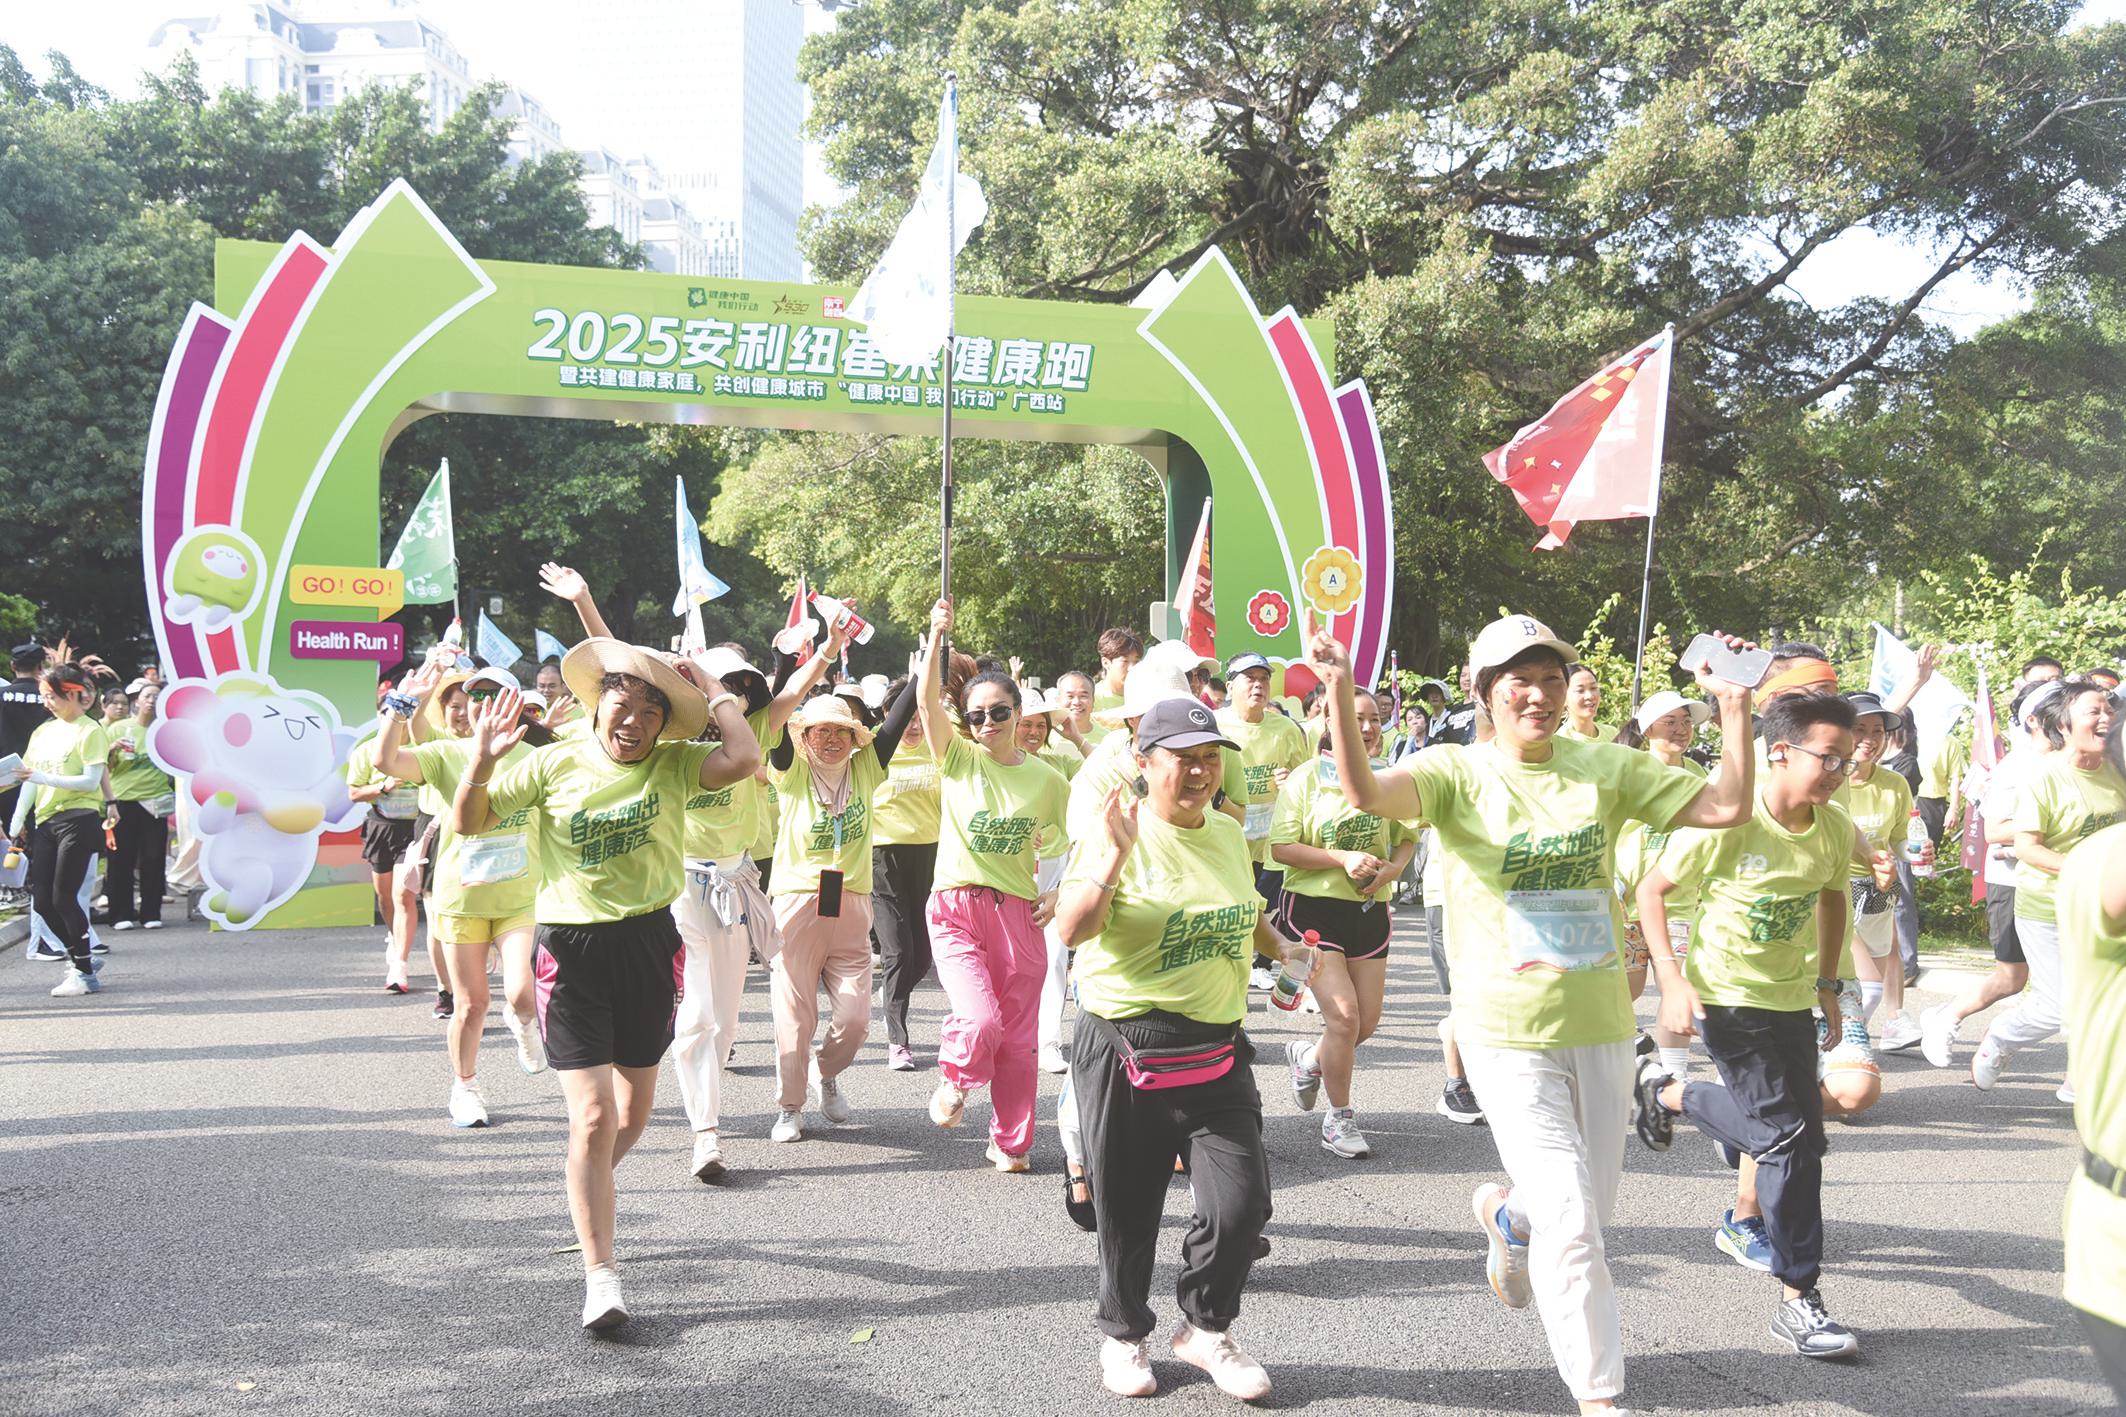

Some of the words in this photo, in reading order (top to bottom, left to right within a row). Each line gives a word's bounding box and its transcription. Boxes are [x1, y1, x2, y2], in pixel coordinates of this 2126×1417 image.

[708, 290, 750, 301] 健康中国
[297, 631, 350, 649] Health
[1521, 619, 1537, 636] B
[570, 793, 660, 845] 自然跑出
[968, 810, 1038, 836] 自然跑出
[576, 823, 657, 869] 健康范
[968, 834, 1032, 855] 健康范
[1502, 822, 1608, 874] 自然跑出
[1511, 853, 1607, 891] 健康范
[1159, 901, 1256, 950] 自然跑出
[1154, 932, 1250, 974] 健康范
